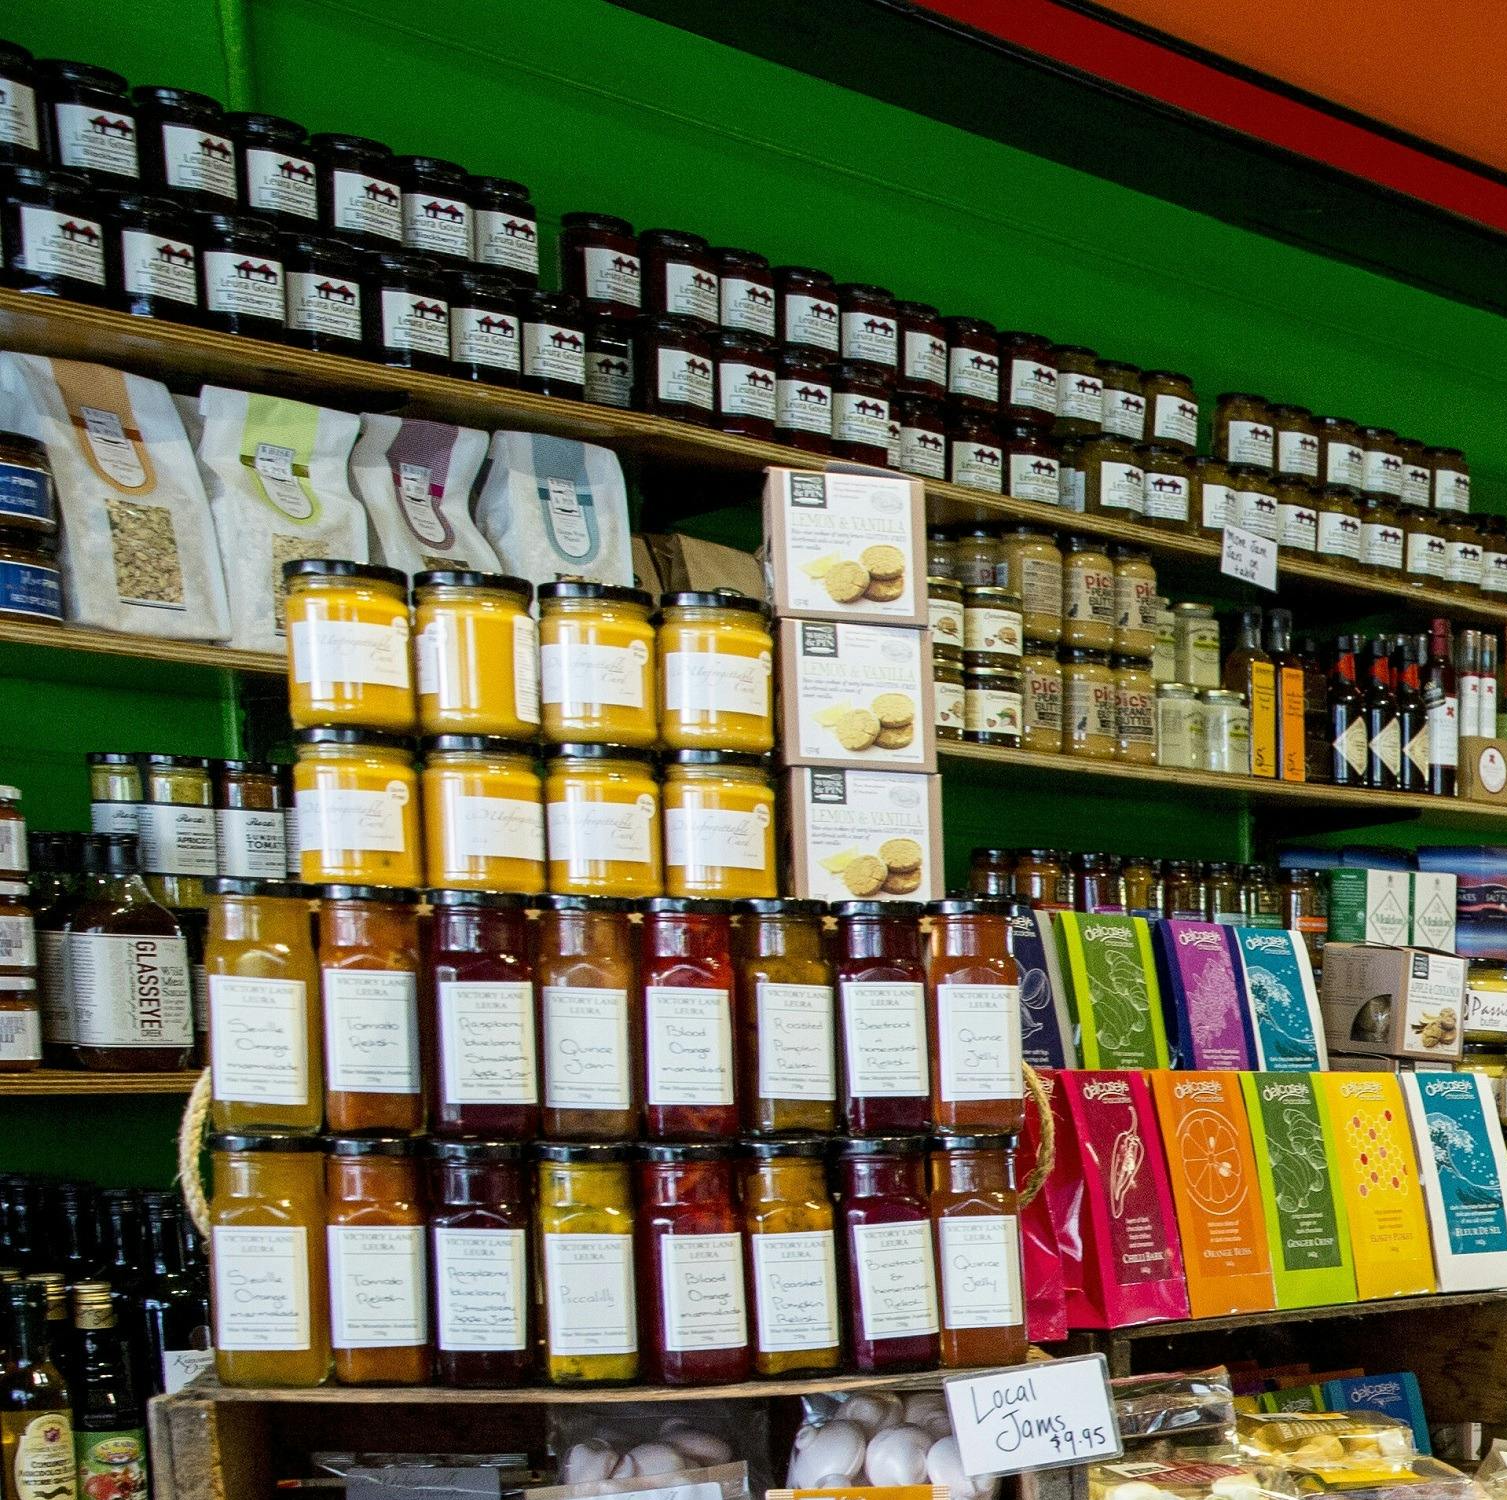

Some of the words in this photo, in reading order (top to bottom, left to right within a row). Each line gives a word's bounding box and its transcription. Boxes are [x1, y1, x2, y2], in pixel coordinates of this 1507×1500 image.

[136, 941, 163, 1029] GLASSEYE
[971, 1378, 1037, 1424] Local
[996, 1409, 1066, 1452] Jams
[1050, 1427, 1106, 1455] $9.95
